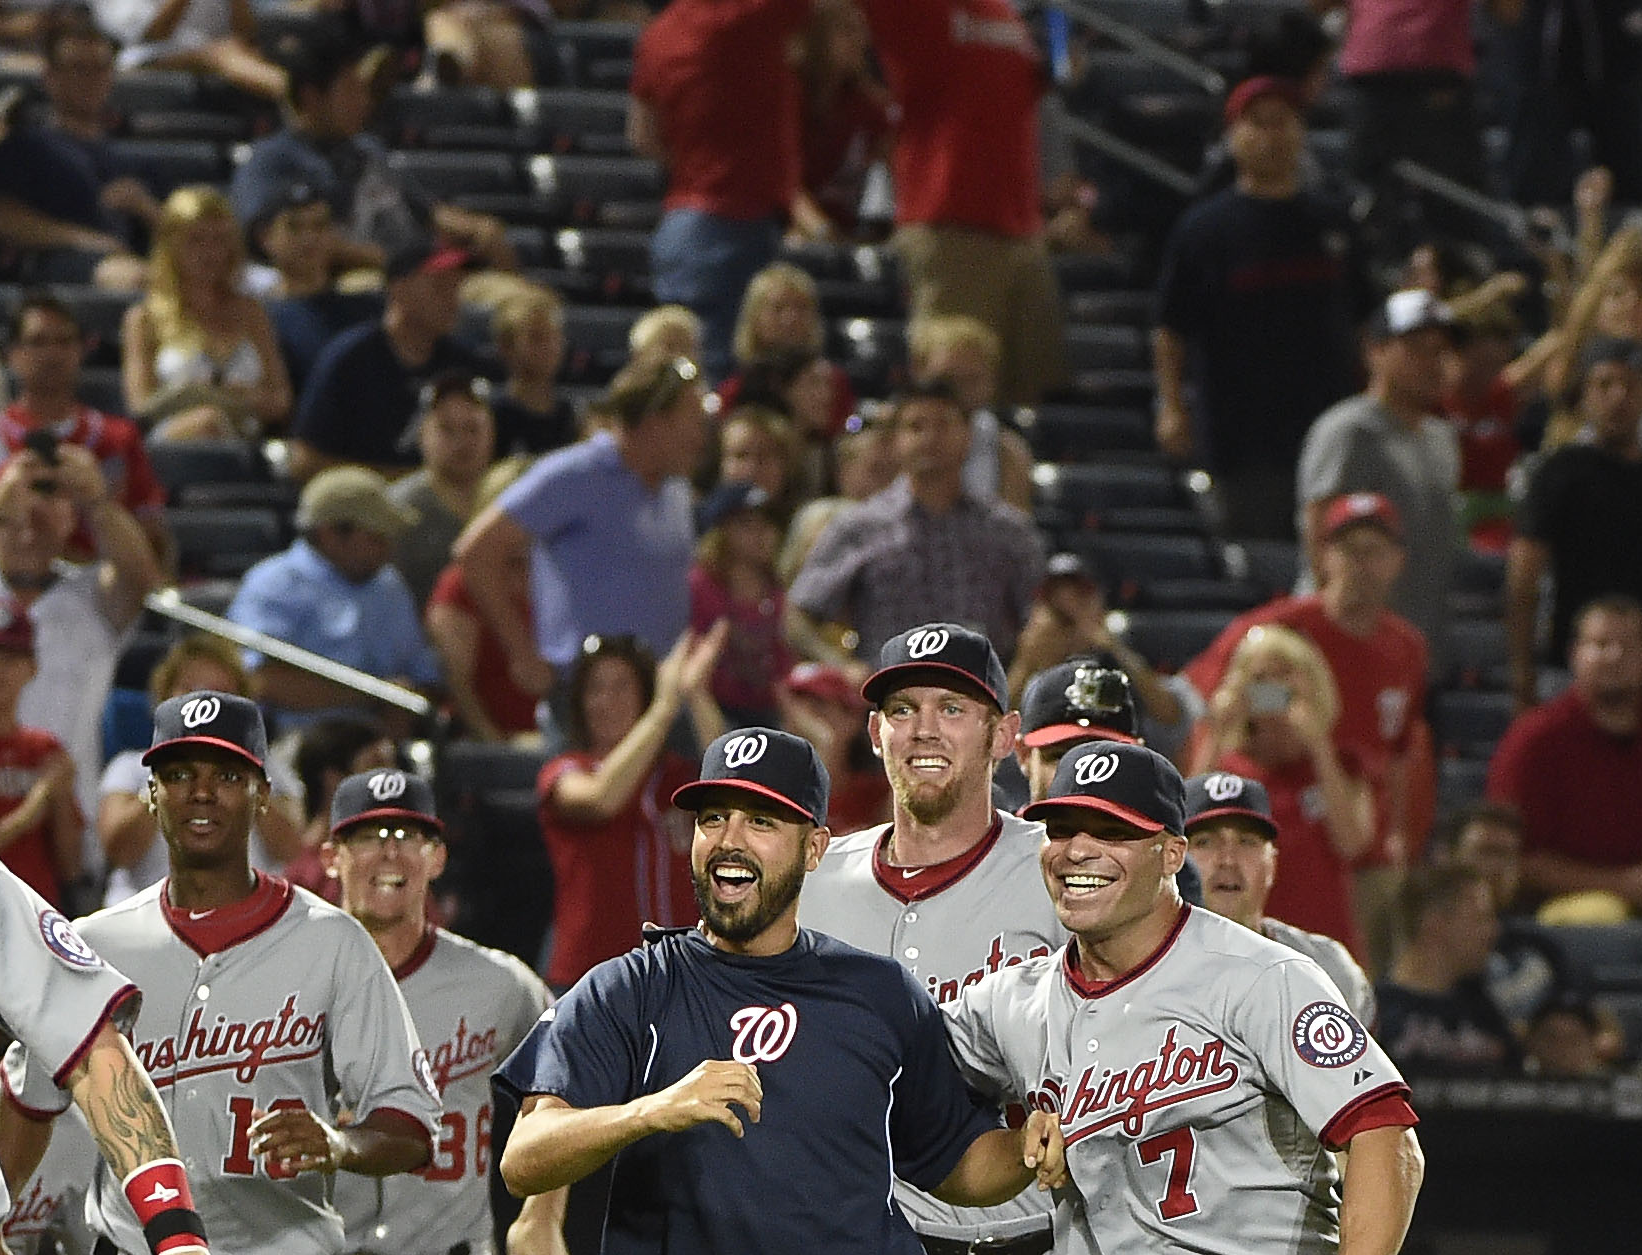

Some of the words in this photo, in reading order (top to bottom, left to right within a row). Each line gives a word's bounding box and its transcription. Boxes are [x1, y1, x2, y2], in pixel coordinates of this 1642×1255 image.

[907, 630, 950, 659] W
[181, 697, 220, 728] W
[724, 734, 767, 768] W
[368, 772, 406, 800] W
[1075, 754, 1119, 785] W
[1205, 775, 1243, 800] W
[127, 991, 325, 1084] ashington
[730, 1003, 798, 1065] W
[1295, 1004, 1351, 1047] WASHINGTON
[1315, 1031, 1366, 1066] NATIONALS
[1136, 1126, 1201, 1222] 7
